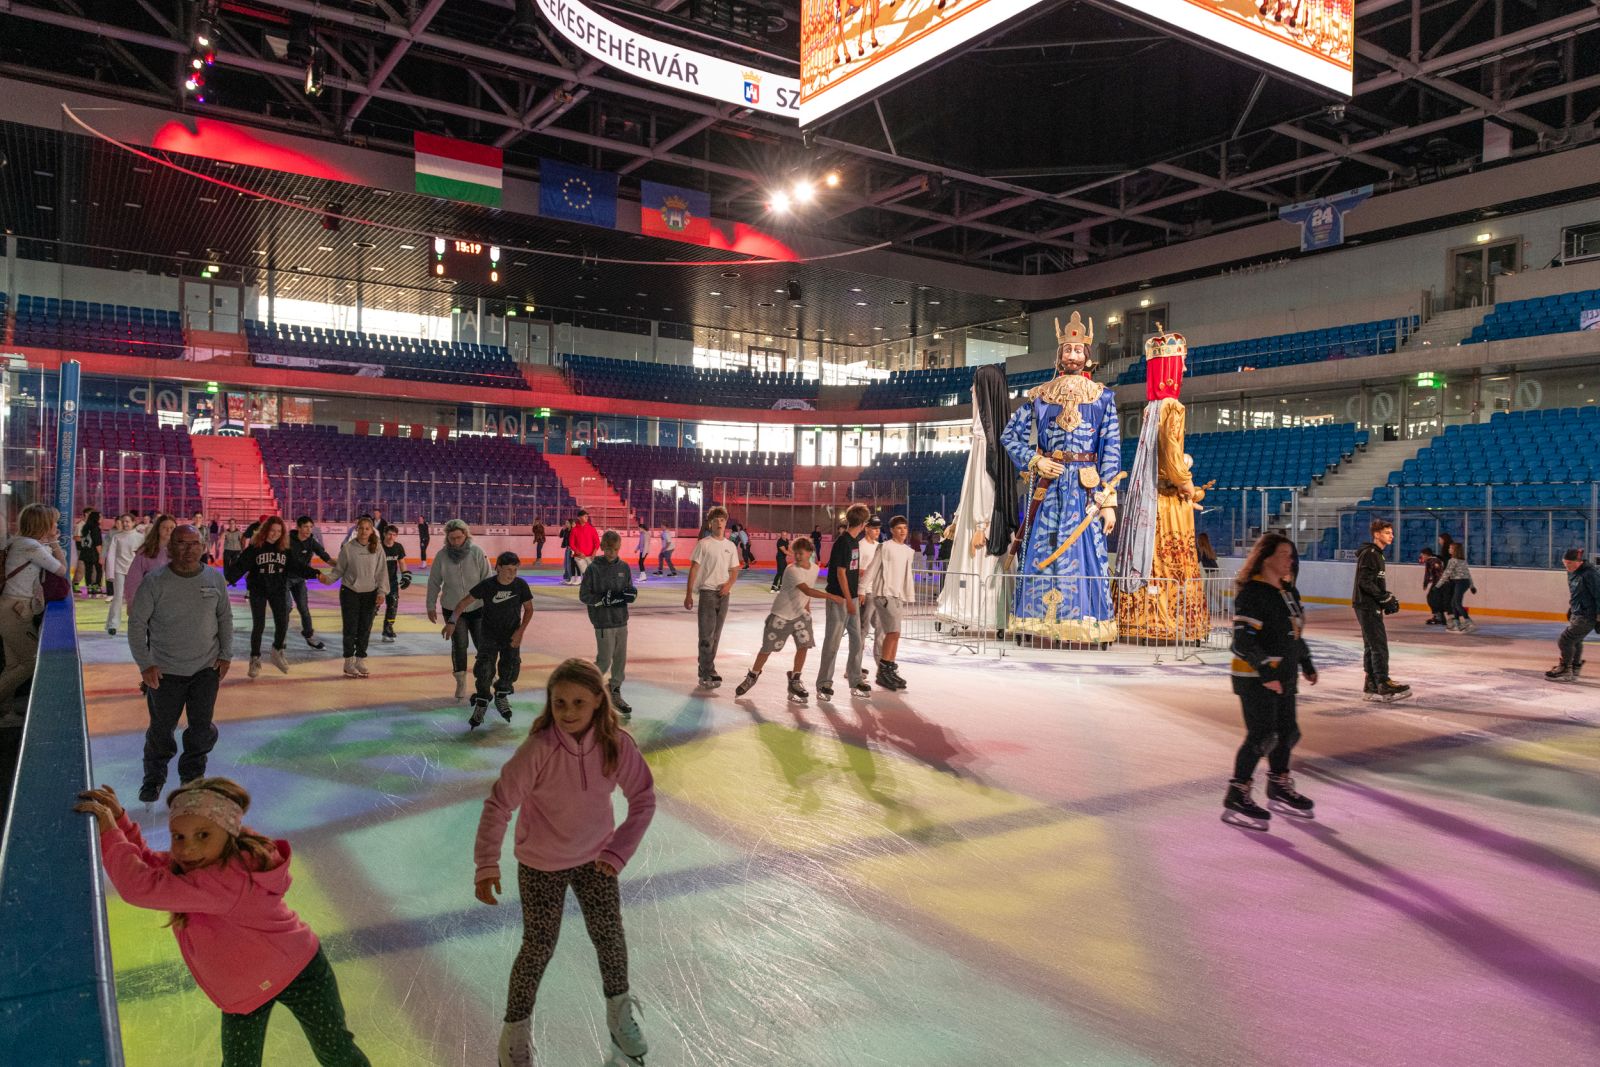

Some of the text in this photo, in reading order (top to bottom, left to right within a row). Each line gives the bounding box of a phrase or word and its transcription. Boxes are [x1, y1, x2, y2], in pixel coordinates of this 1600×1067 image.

[543, 0, 698, 85] KESFEHÉRVÁR
[1312, 206, 1333, 226] 24
[455, 241, 482, 254] 15:19
[436, 264, 444, 275] 0
[491, 271, 498, 282] 0
[496, 590, 512, 599] NIKE
